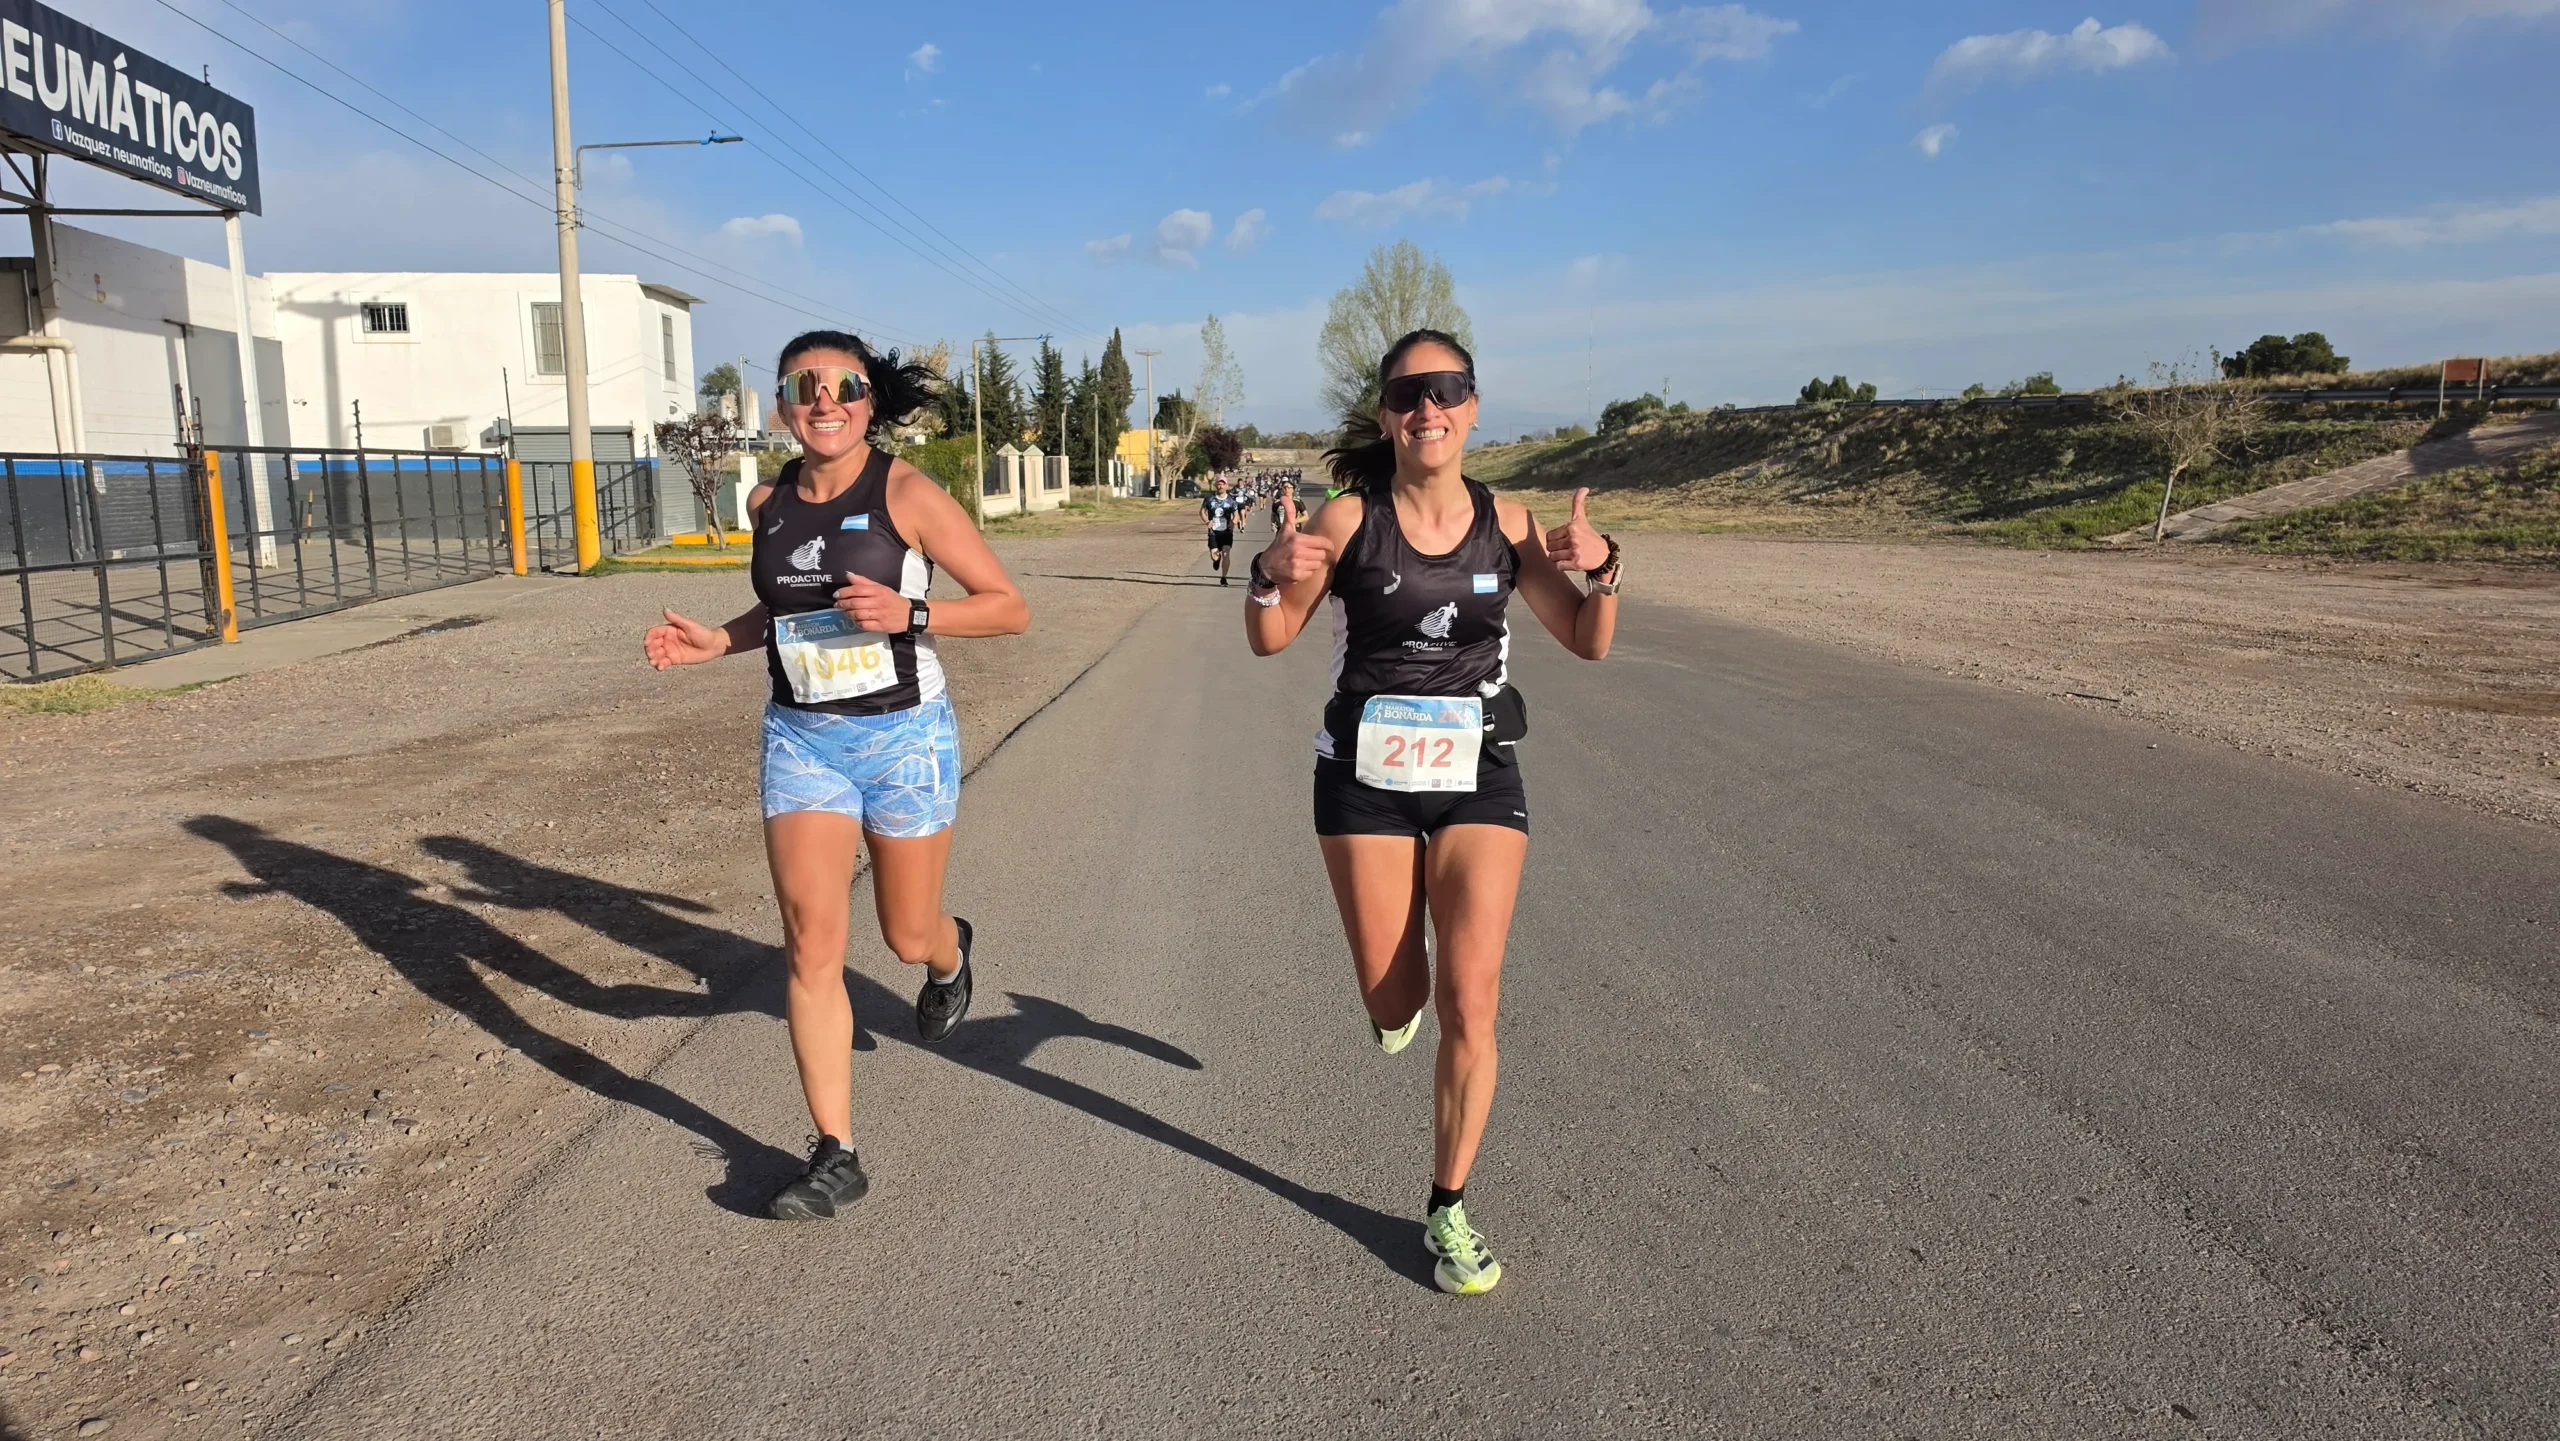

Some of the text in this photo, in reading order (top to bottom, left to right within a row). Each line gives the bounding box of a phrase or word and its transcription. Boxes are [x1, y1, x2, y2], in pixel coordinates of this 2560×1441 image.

[0, 18, 242, 181] EUMÁTICOS
[64, 124, 172, 179] Vazquez neumaticos
[185, 171, 247, 206] Vazneumaticos
[776, 574, 833, 585] PROACTIVE
[797, 624, 839, 637] BONARDA
[794, 641, 880, 681] 1046
[1384, 709, 1434, 722] BONARDA
[1382, 735, 1454, 768] 212
